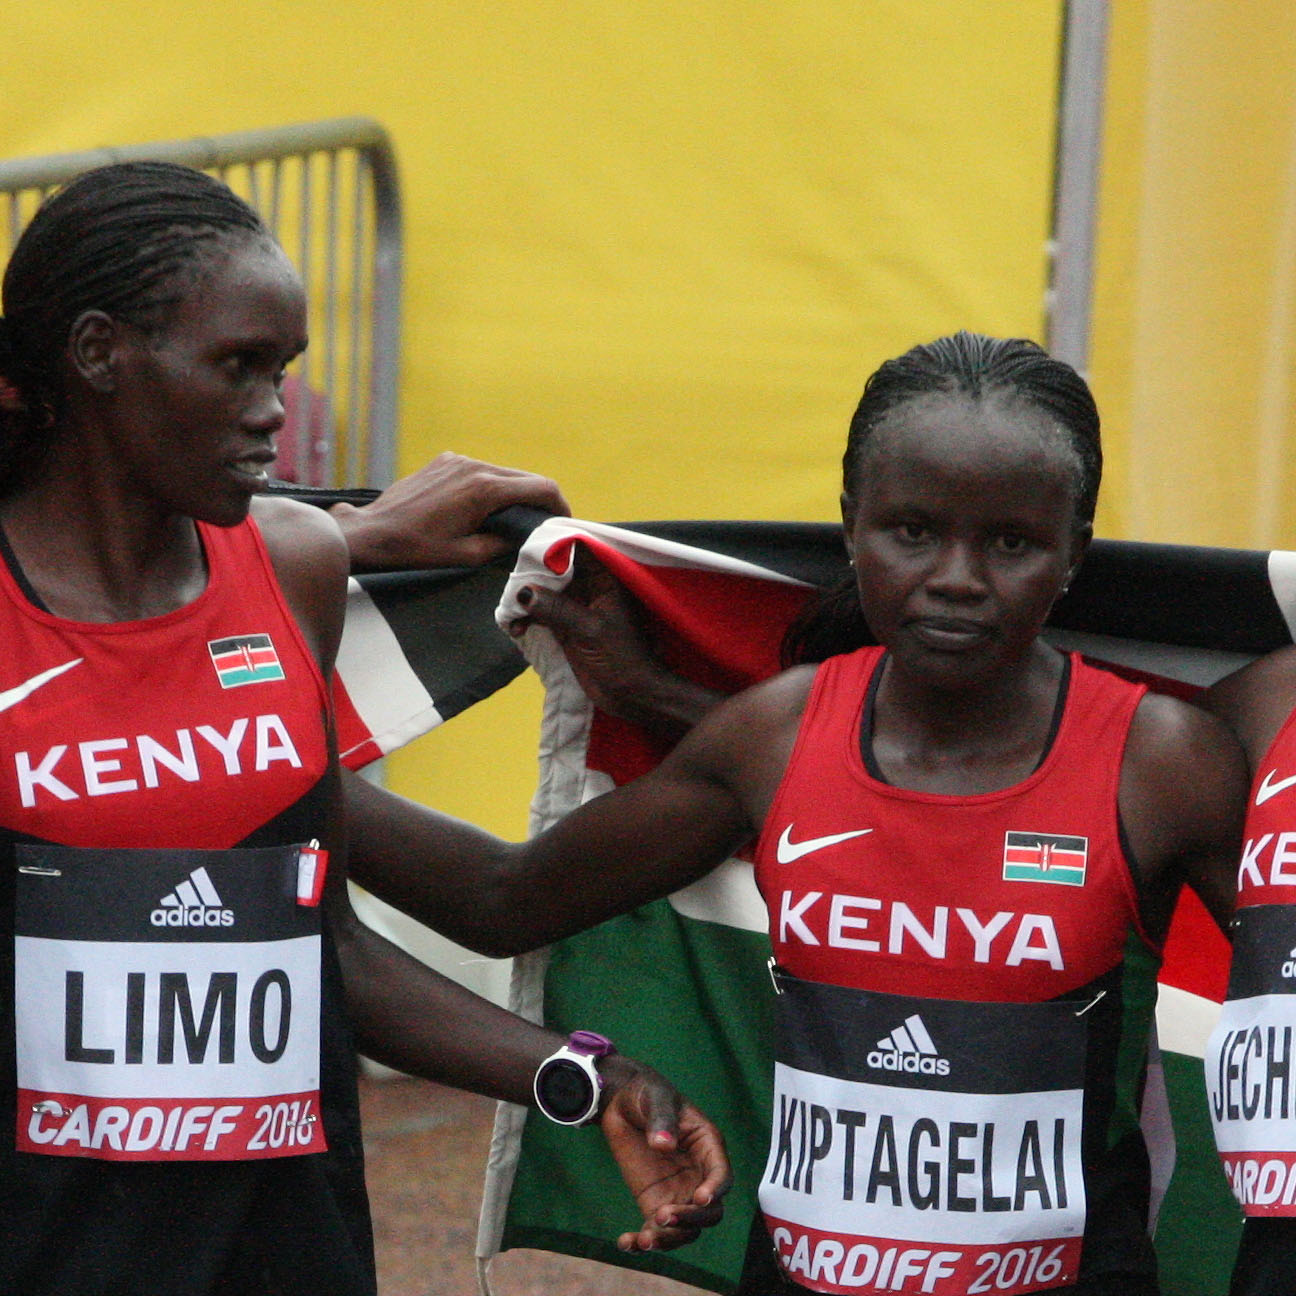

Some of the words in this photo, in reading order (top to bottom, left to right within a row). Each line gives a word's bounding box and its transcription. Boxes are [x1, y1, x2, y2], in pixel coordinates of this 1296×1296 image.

[14, 713, 302, 808] KENYA
[150, 904, 235, 928] adidas
[779, 889, 1065, 971] KENYA
[64, 968, 292, 1066] LIMO
[866, 1049, 951, 1077] adidas
[27, 1099, 244, 1152] CARDIFF
[247, 1099, 315, 1151] 2016
[769, 1093, 1068, 1213] KIPTAGELAI
[773, 1226, 964, 1294] CARDIFF
[966, 1243, 1066, 1296] 2016
